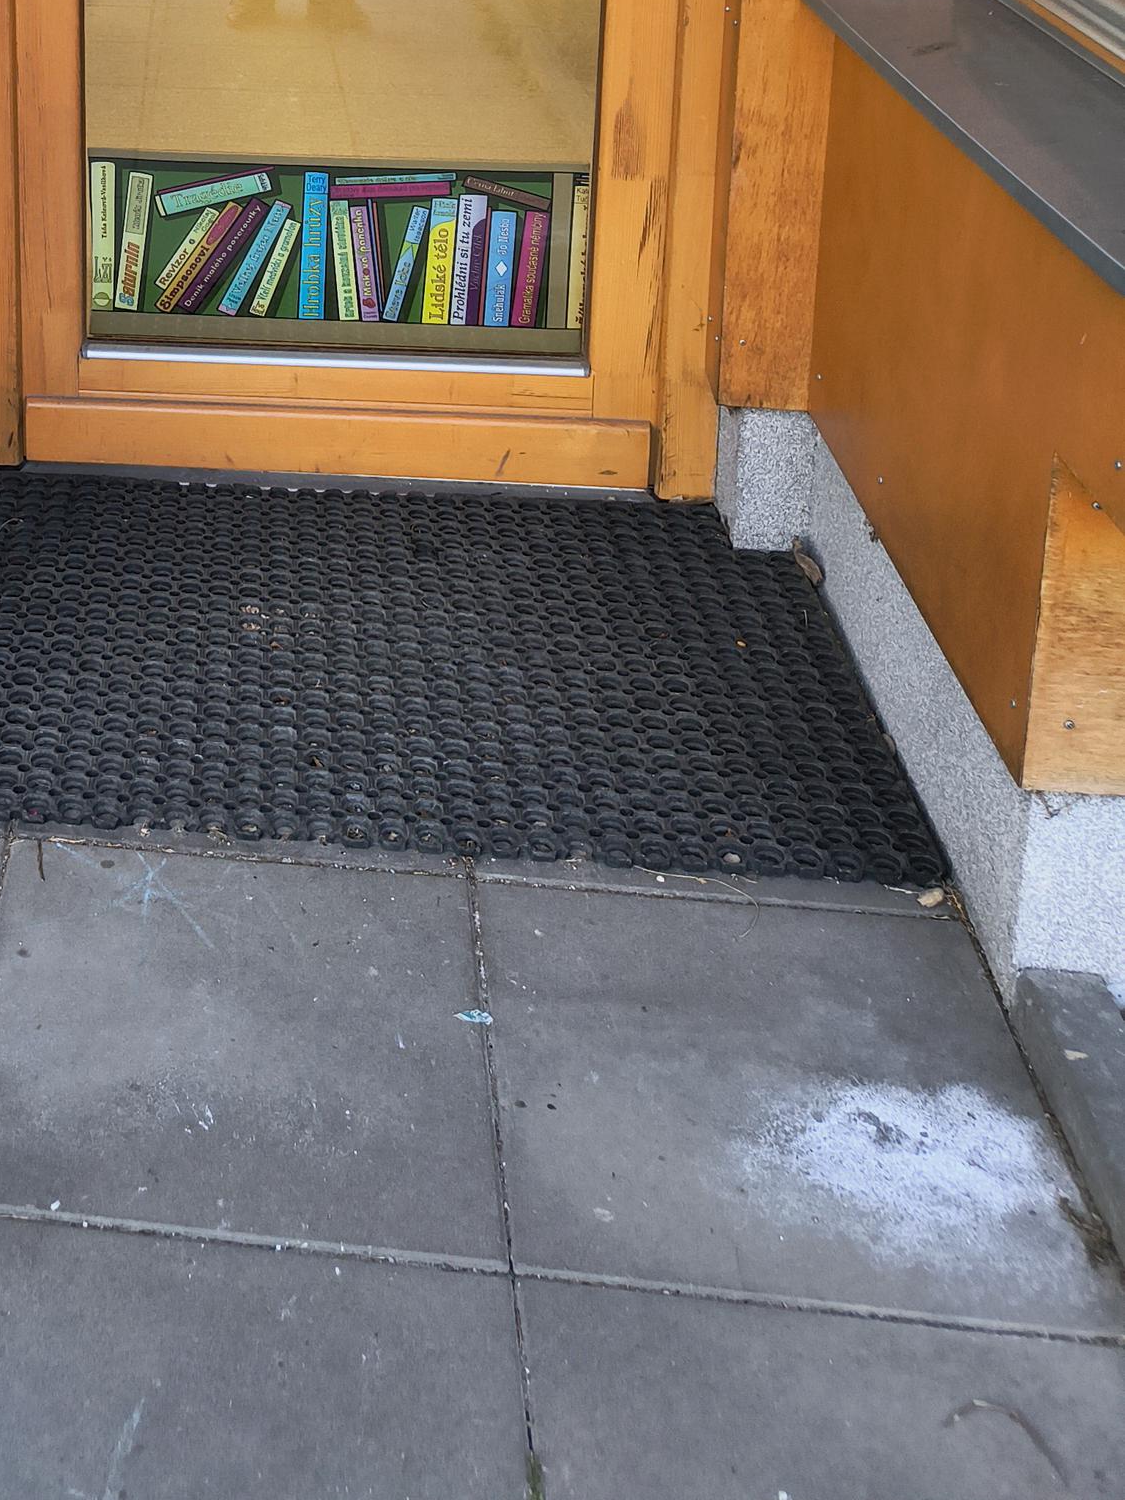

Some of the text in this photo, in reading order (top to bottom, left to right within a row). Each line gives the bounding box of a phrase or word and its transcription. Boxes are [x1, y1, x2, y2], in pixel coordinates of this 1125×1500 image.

[158, 248, 190, 286] Revizor
[159, 244, 210, 311] Simpsonovi
[184, 204, 262, 308] Deník malého poseroutky
[302, 254, 320, 317] Hrobka
[452, 197, 473, 321] Prohlédni si tu zemi
[429, 265, 447, 320] Lidské
[492, 282, 506, 322] Sněhulák
[518, 285, 535, 326] Gramatika
